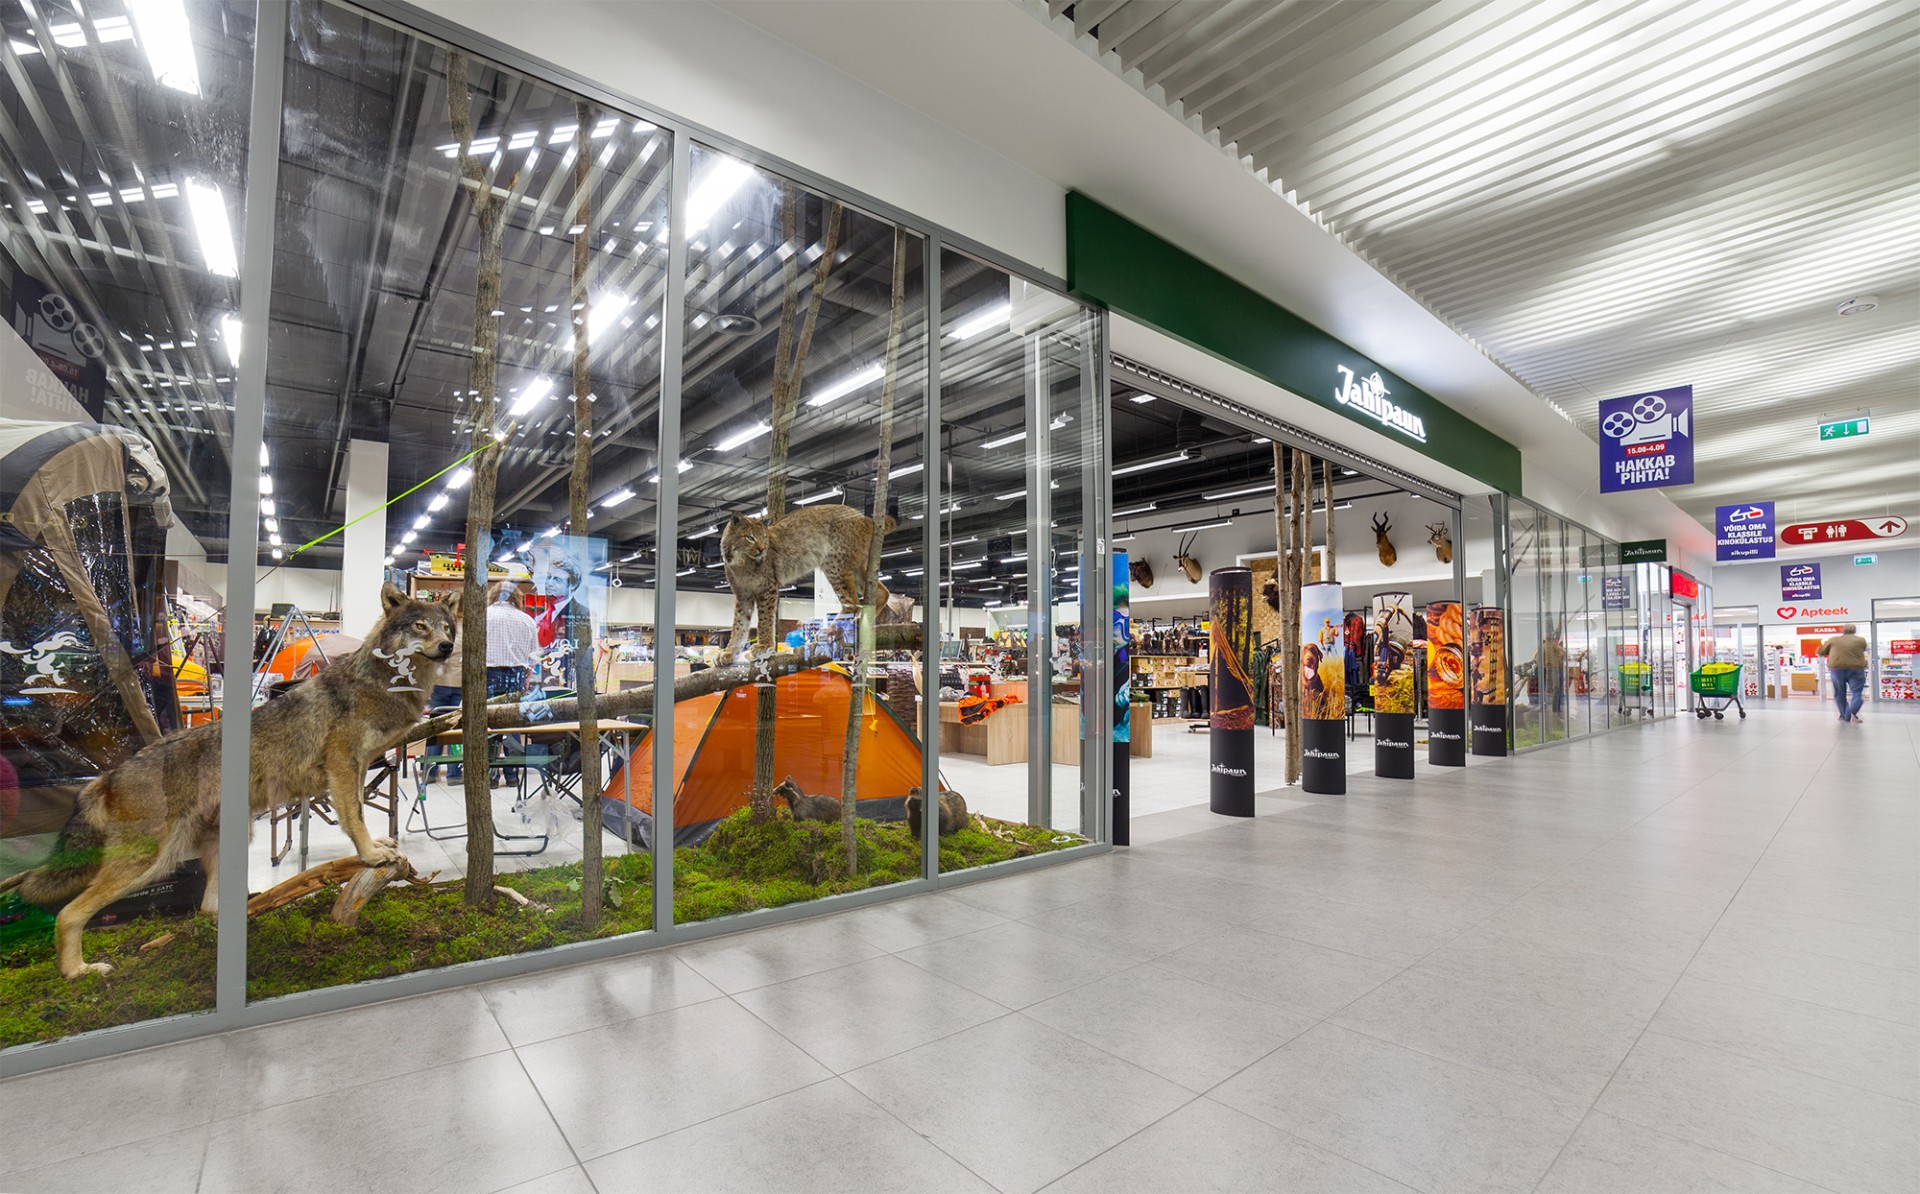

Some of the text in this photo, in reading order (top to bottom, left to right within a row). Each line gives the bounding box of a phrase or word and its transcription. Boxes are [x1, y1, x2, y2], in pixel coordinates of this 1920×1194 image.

[1335, 364, 1427, 440] Jahipaun
[1615, 454, 1676, 474] HAKKAB
[1620, 467, 1670, 485] PIHTA!
[1723, 523, 1767, 532] VÕIDA OMA
[1727, 530, 1763, 539] KLASSILE
[1717, 536, 1773, 546] KINOKÜLASTUS
[1801, 607, 1849, 618] Apteek
